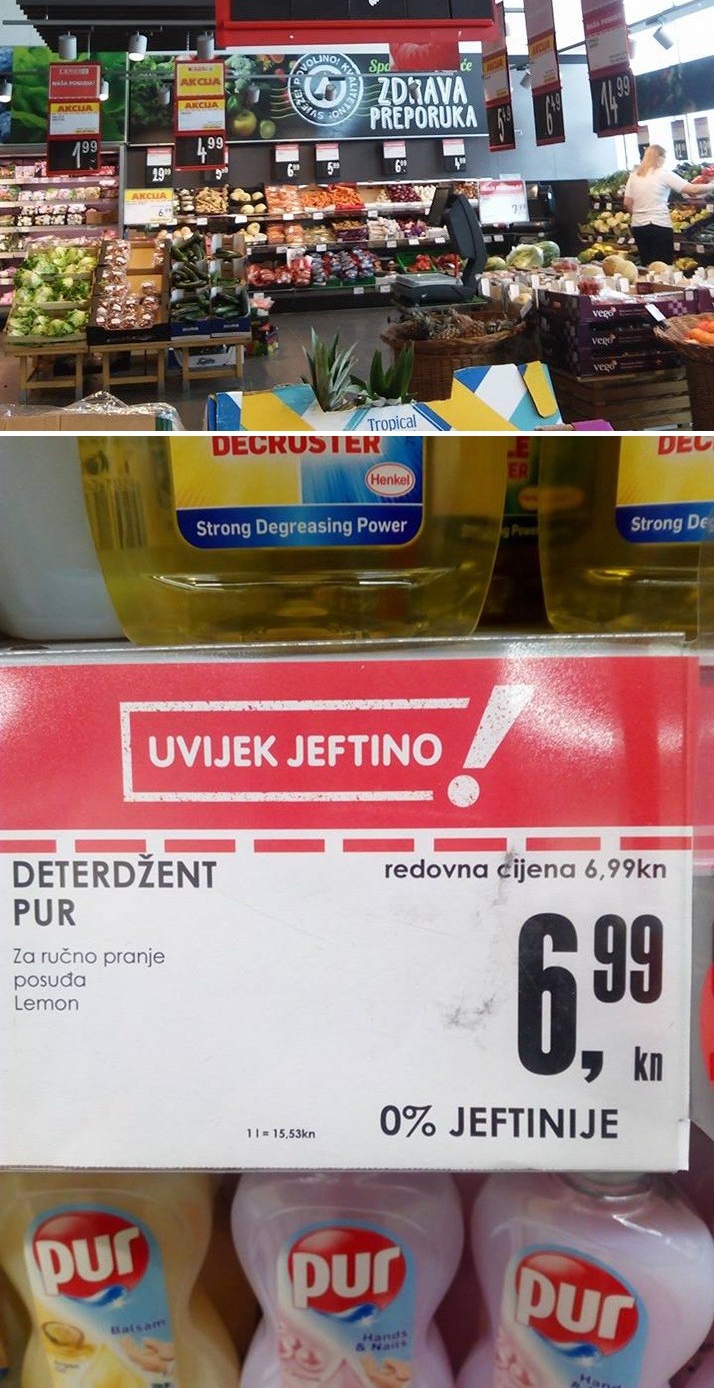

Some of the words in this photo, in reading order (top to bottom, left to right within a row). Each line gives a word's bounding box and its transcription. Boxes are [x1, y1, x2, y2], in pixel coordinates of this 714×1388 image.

[180, 77, 222, 87] AKCIJA
[377, 76, 469, 106] ZDRAVA
[184, 101, 219, 109] AKCIJA
[369, 105, 479, 131] PREPORUKA
[367, 415, 417, 432] Tropical
[211, 436, 381, 457] DECRUSTER
[369, 473, 411, 488] Henkel
[196, 520, 251, 539] Strong
[255, 517, 352, 538] Degreasing
[356, 516, 408, 534] Power
[630, 516, 683, 534] Strong
[147, 735, 277, 768] UVIJEK
[286, 732, 443, 768] JEFTINO
[12, 853, 218, 889] DETERDŽENT
[384, 858, 489, 879] redovna
[496, 858, 577, 884] cijena
[584, 858, 668, 882] 6,99kn
[13, 898, 77, 927] PUR
[13, 947, 36, 964] Za
[41, 947, 98, 965] ručno
[103, 947, 166, 968] pranje
[14, 971, 87, 991] posuđa
[14, 994, 80, 1011] Lemon
[633, 1046, 664, 1082] kn
[379, 1104, 437, 1139] 0%
[448, 1106, 619, 1140] JEFTINIJE
[246, 1128, 252, 1139] 1
[35, 1226, 141, 1297] pur
[292, 1245, 402, 1310] pur
[516, 1265, 637, 1341] pur
[110, 1317, 167, 1336] Balsam
[362, 1329, 409, 1343] Hands
[371, 1339, 409, 1353] Nails
